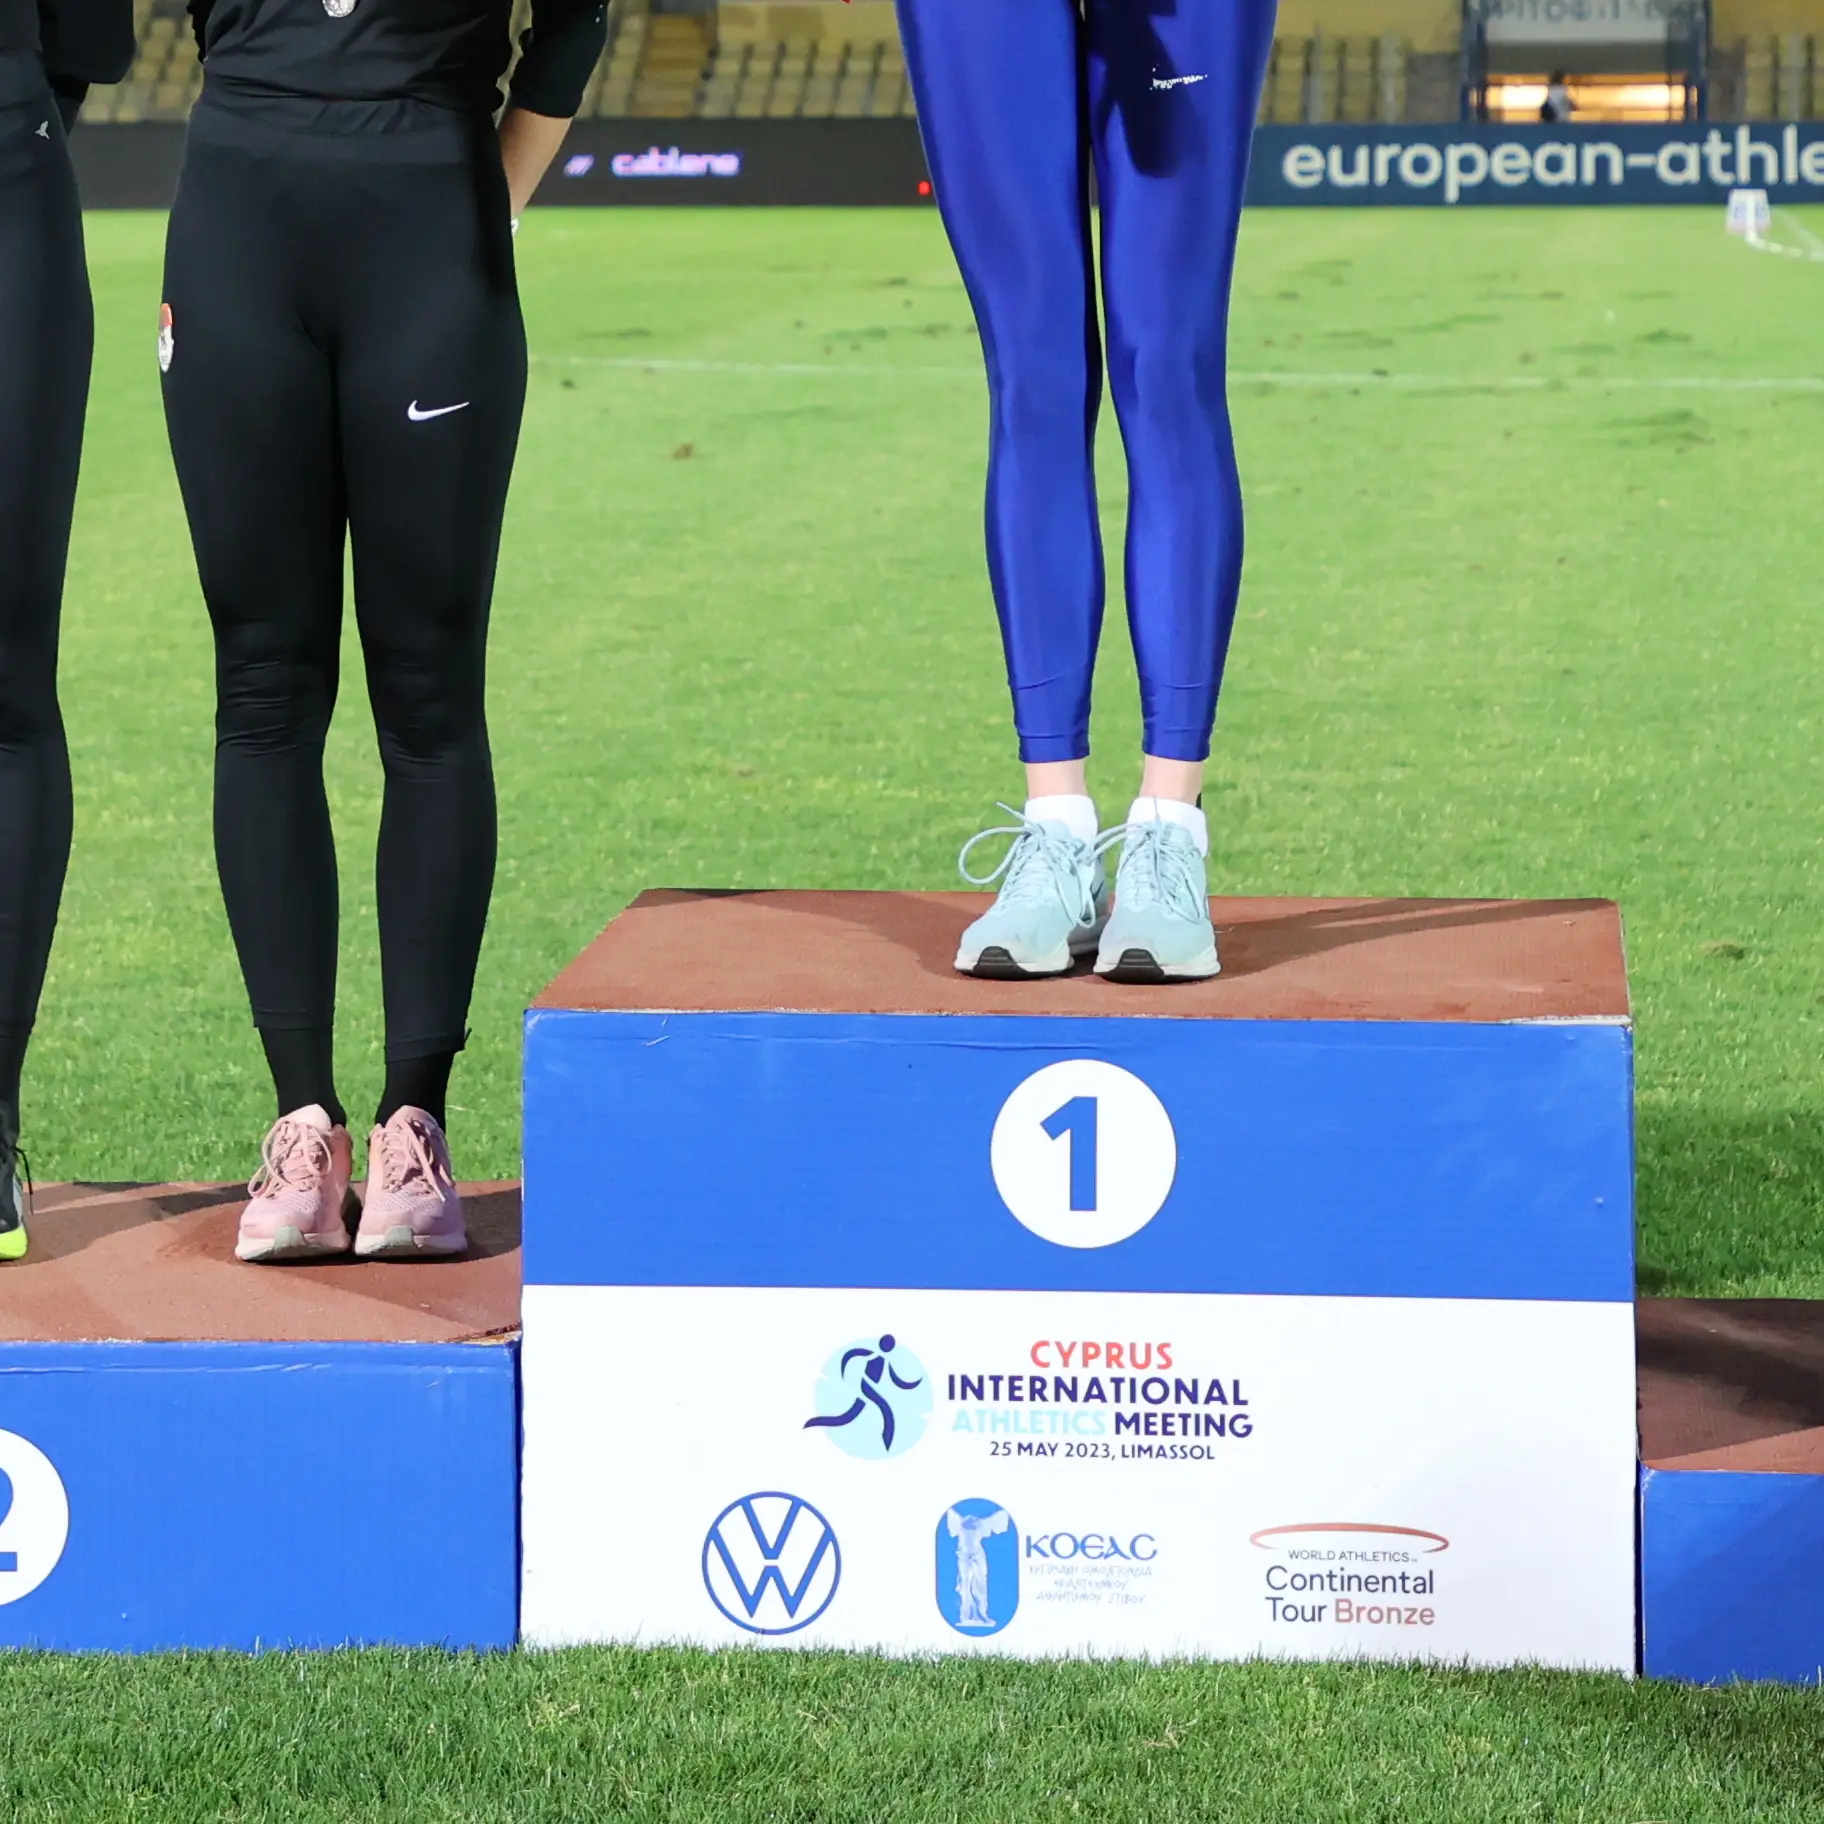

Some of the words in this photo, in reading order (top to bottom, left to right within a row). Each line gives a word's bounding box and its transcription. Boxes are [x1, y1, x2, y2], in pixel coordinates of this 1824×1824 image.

[1040, 1096, 1099, 1213] 1
[1030, 1340, 1174, 1371] CYPRUS
[948, 1373, 1250, 1407] INTERNATIONAL
[951, 1408, 1107, 1436] ATHLETICS
[1115, 1412, 1254, 1438] MEETING
[990, 1441, 1013, 1457] 25
[1017, 1443, 1059, 1457] MAY
[1065, 1443, 1116, 1461] 2023,
[1121, 1444, 1216, 1460] LIMASSOL
[1288, 1549, 1336, 1562] WORLD
[1339, 1551, 1410, 1563] ATHLETICS
[1266, 1565, 1434, 1595] Continental
[1265, 1596, 1328, 1623] Tour
[1334, 1598, 1436, 1626] Bronze
